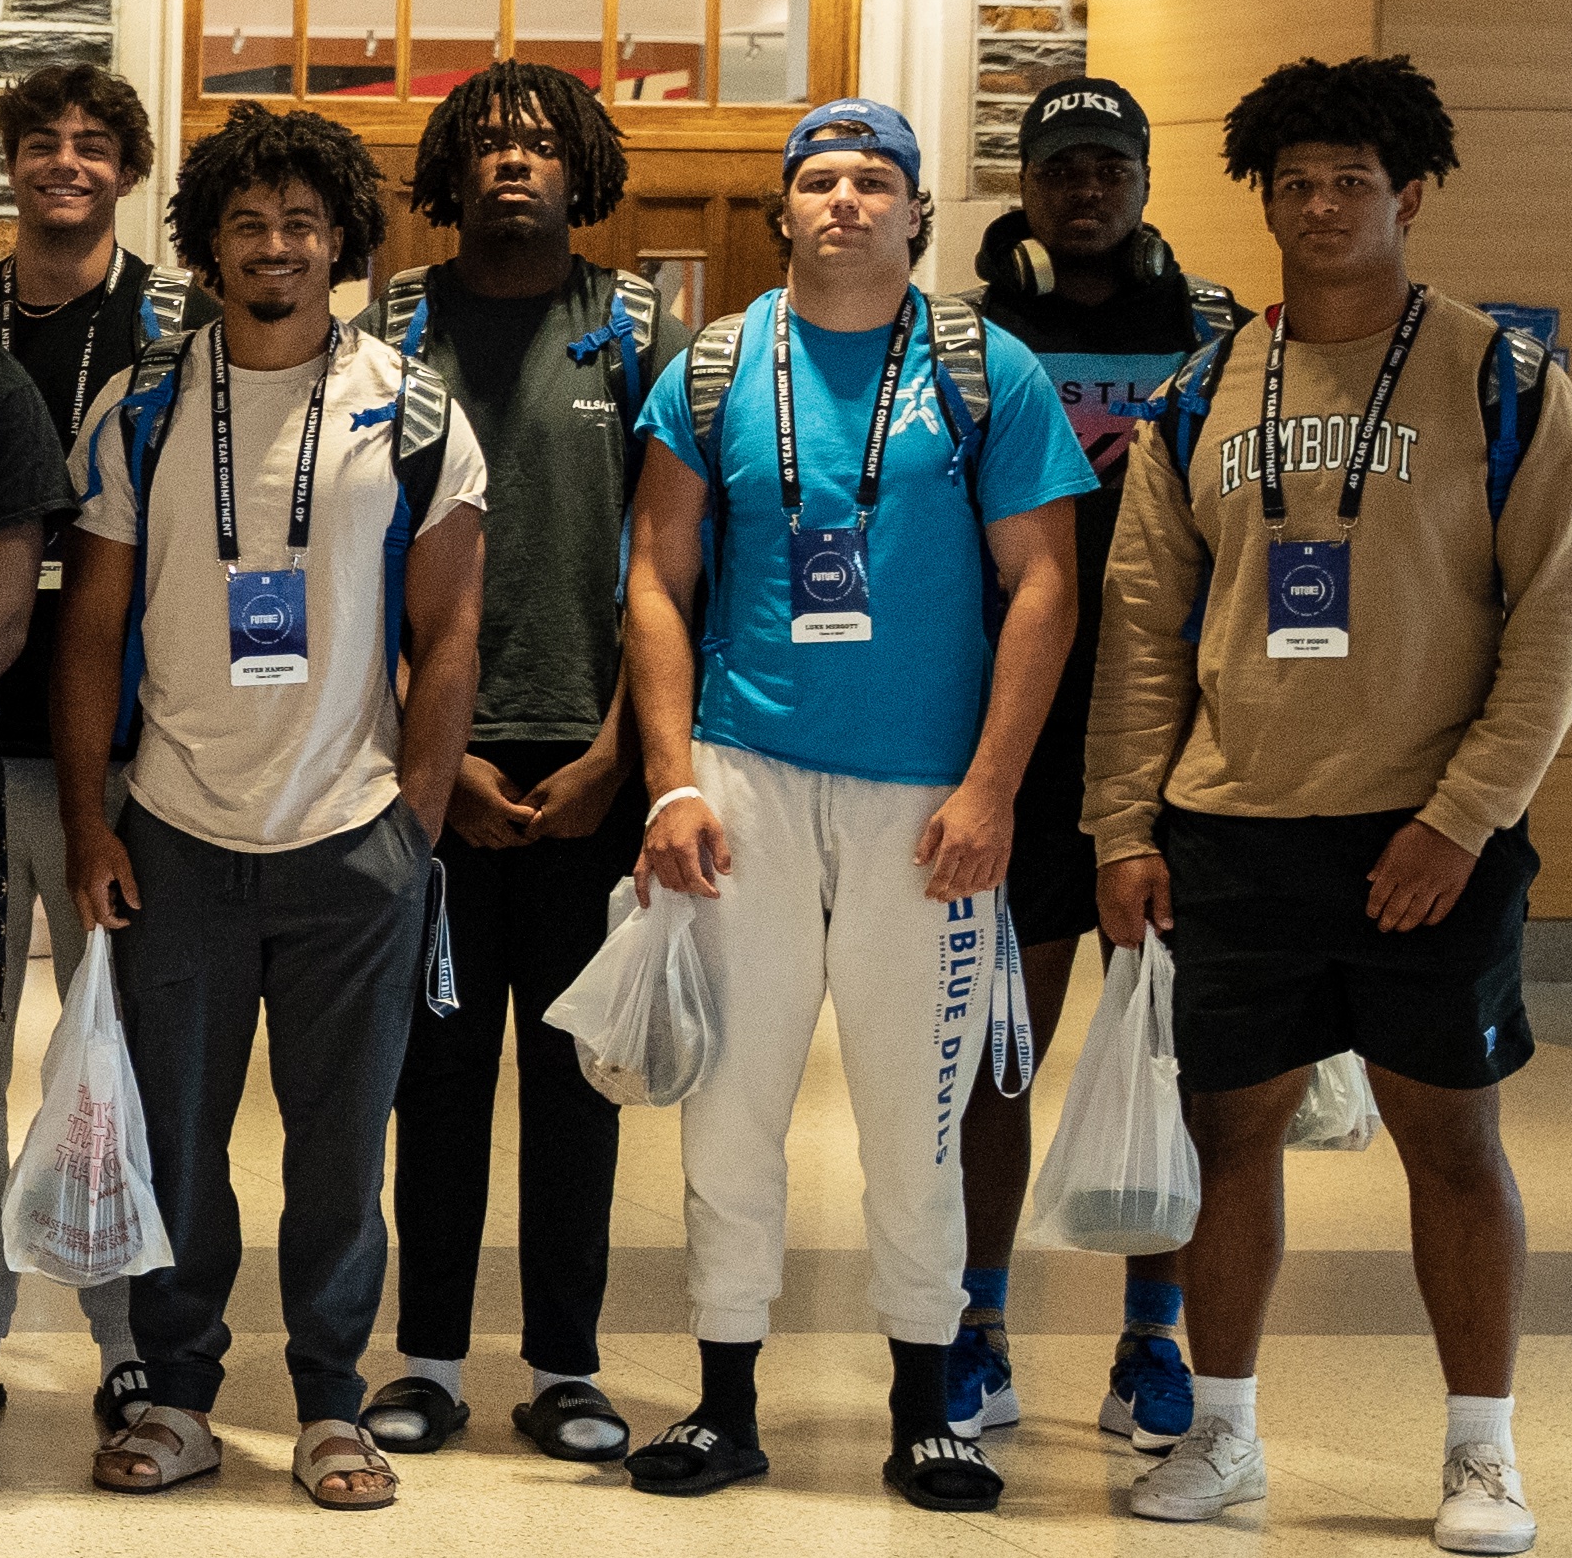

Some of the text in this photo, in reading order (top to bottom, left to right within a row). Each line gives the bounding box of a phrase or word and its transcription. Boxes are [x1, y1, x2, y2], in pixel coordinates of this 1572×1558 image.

[1040, 91, 1122, 124] DUKE
[1401, 325, 1412, 340] 40
[295, 406, 320, 523] 40 YEAR COMMITMENT
[777, 369, 794, 484] 40 YEAR COMMITMENT
[866, 363, 898, 479] 40 YEAR COMMITMENT
[1266, 377, 1278, 489] 40 YEAR COMMITMENT
[1349, 372, 1392, 489] 40 YEAR COMMITMENT
[218, 420, 232, 538] 40 YEAR COMMITMENT
[935, 930, 977, 1166] BLUE DEVILS
[112, 1369, 149, 1397] NI
